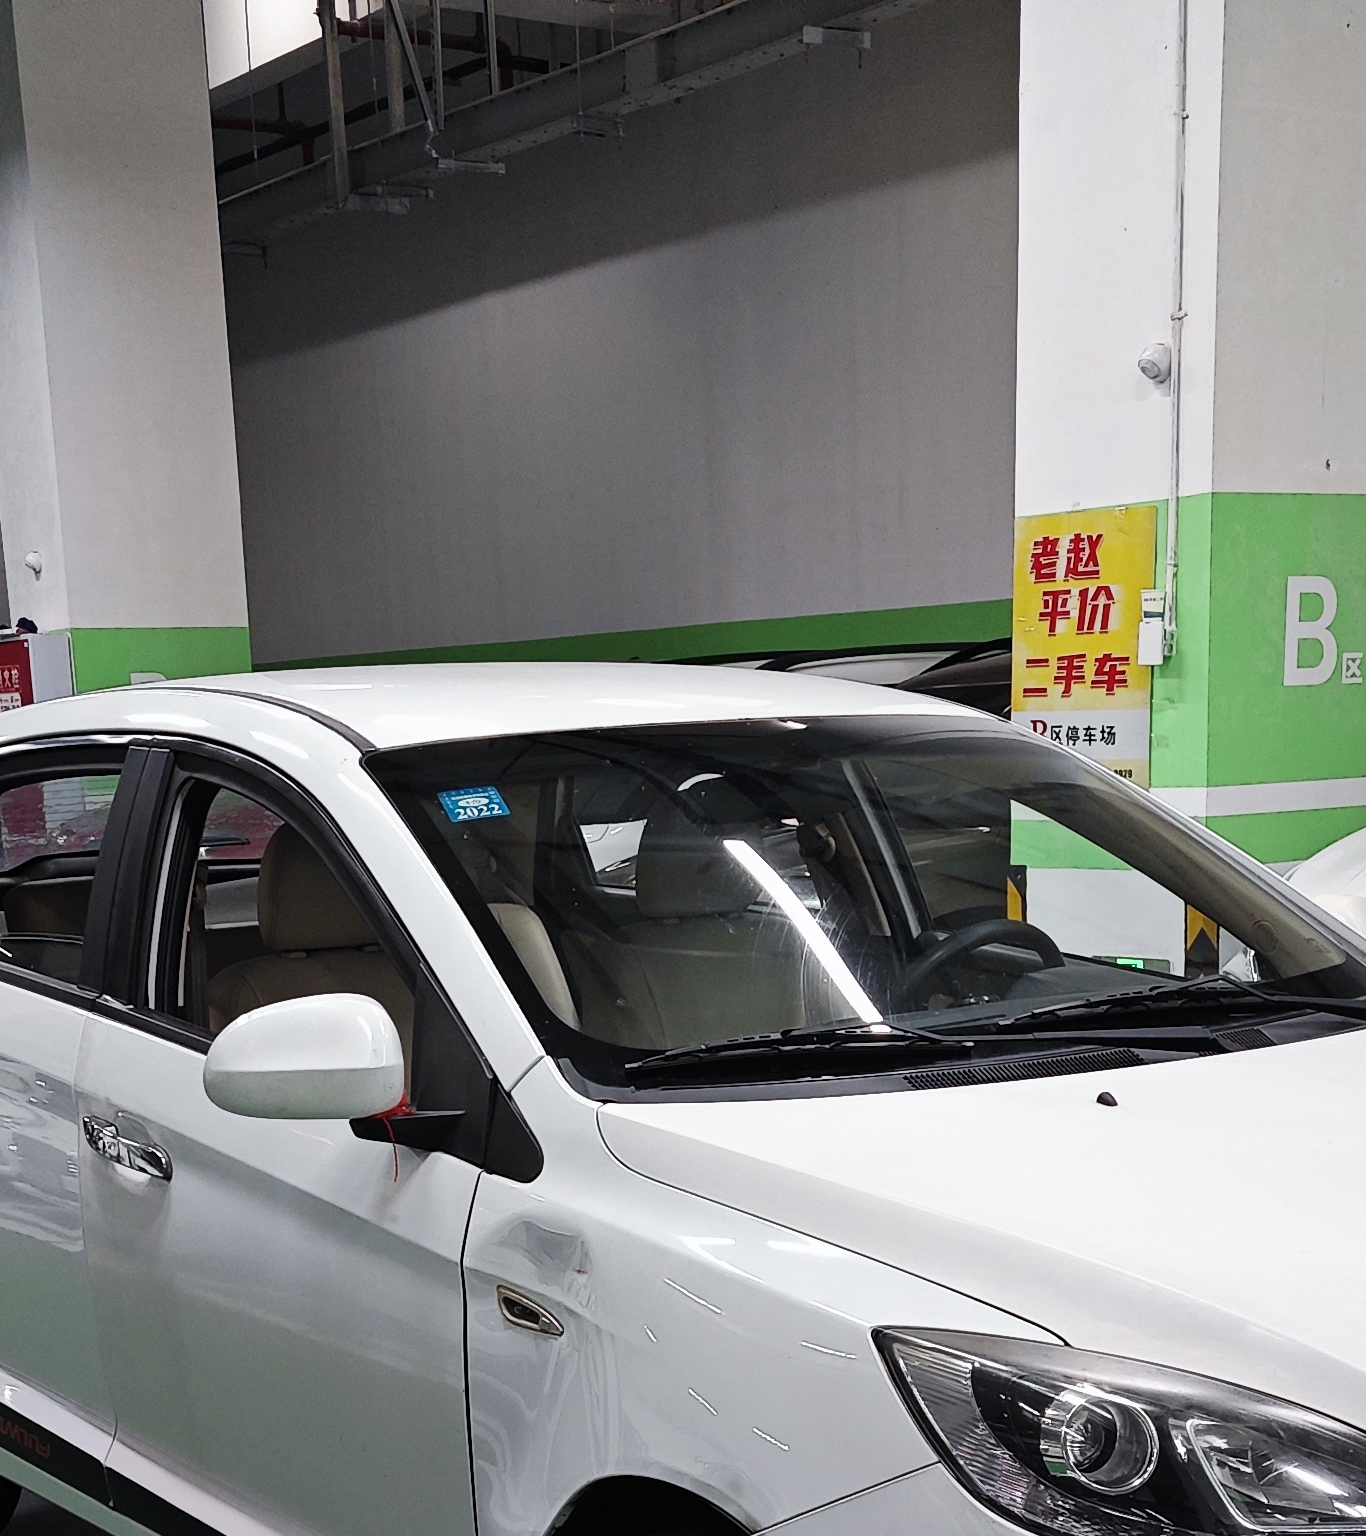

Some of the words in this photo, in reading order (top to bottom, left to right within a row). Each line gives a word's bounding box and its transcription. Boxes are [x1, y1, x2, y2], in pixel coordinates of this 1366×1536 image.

[1030, 533, 1104, 583] 老赵
[1038, 585, 1115, 636] 平价
[1283, 574, 1364, 687] B区
[1022, 652, 1131, 698] 二手车
[454, 804, 503, 820] 2022
